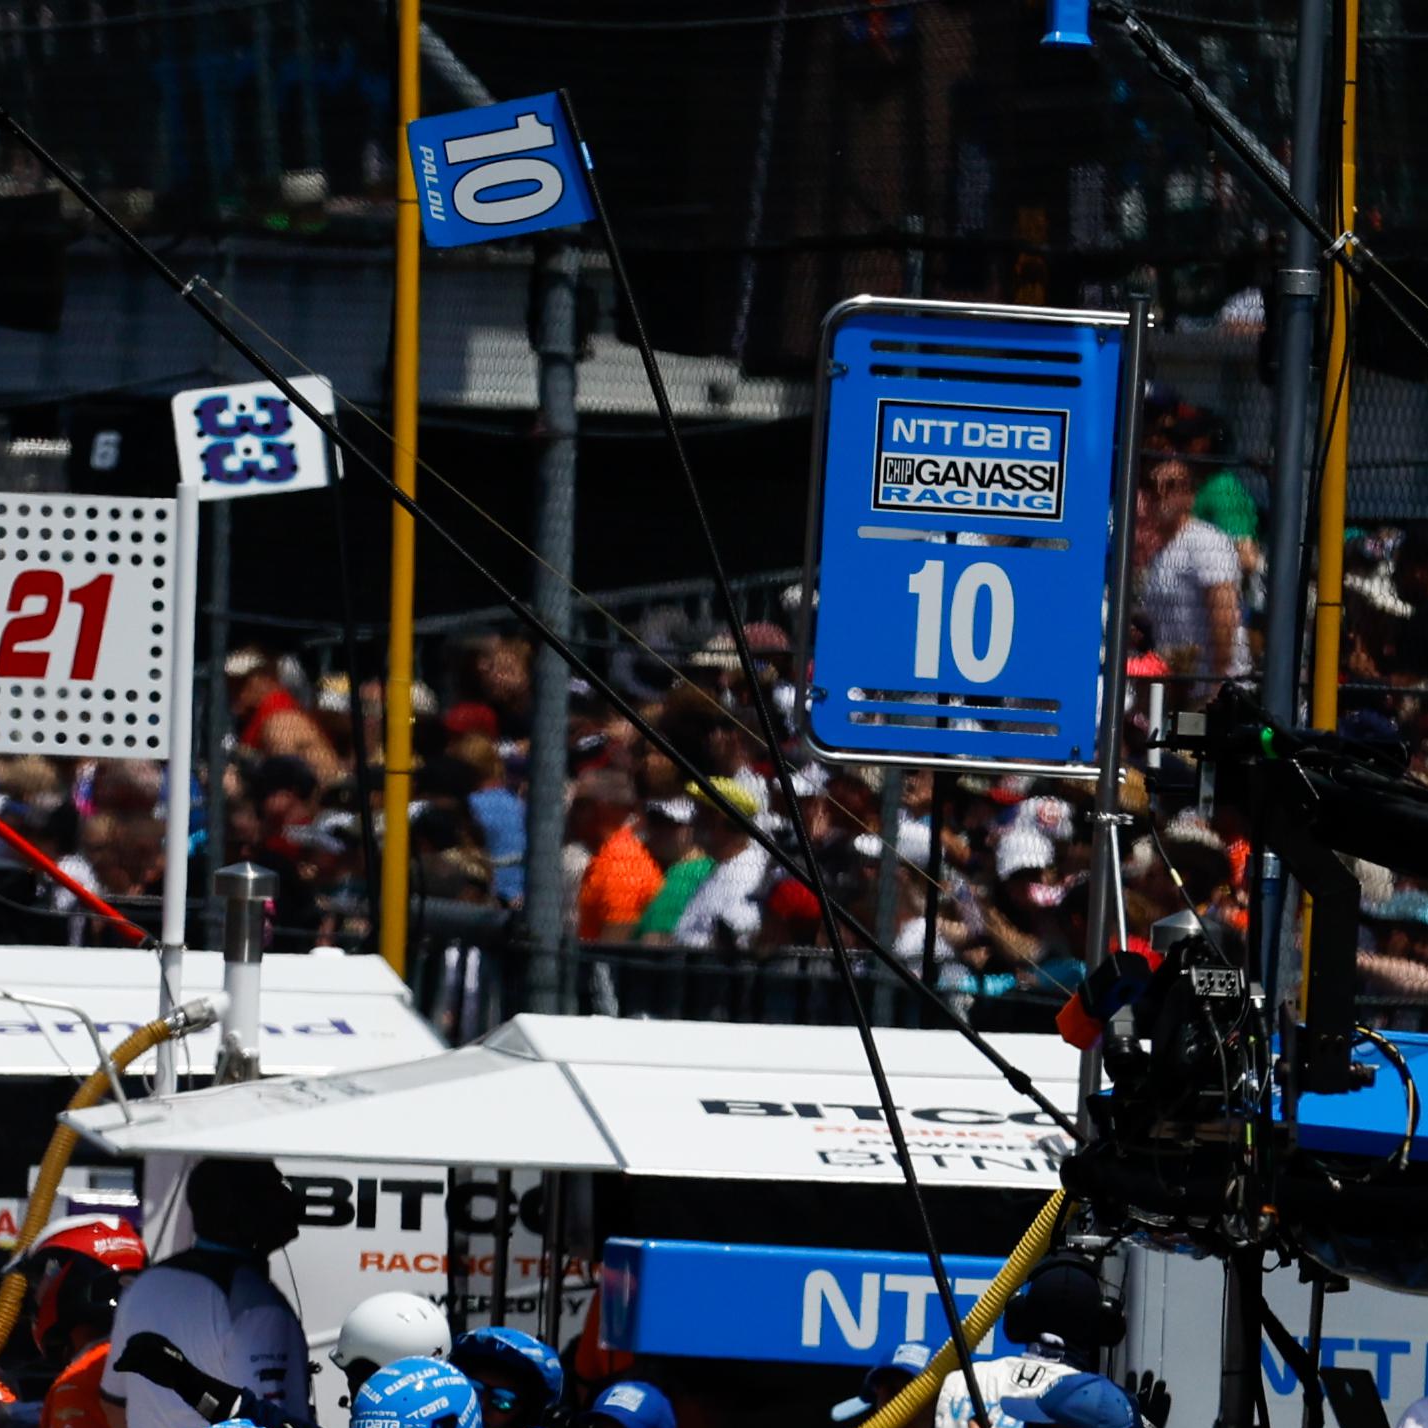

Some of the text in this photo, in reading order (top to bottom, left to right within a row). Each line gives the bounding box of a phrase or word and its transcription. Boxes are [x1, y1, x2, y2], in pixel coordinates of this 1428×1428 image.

[417, 145, 446, 222] PALOU
[443, 114, 563, 226] 10
[197, 395, 298, 486] 33
[892, 417, 959, 448] NTT
[881, 486, 1053, 513] RACING
[884, 457, 1056, 495] CHIP GANASSI
[907, 560, 1014, 684] 10
